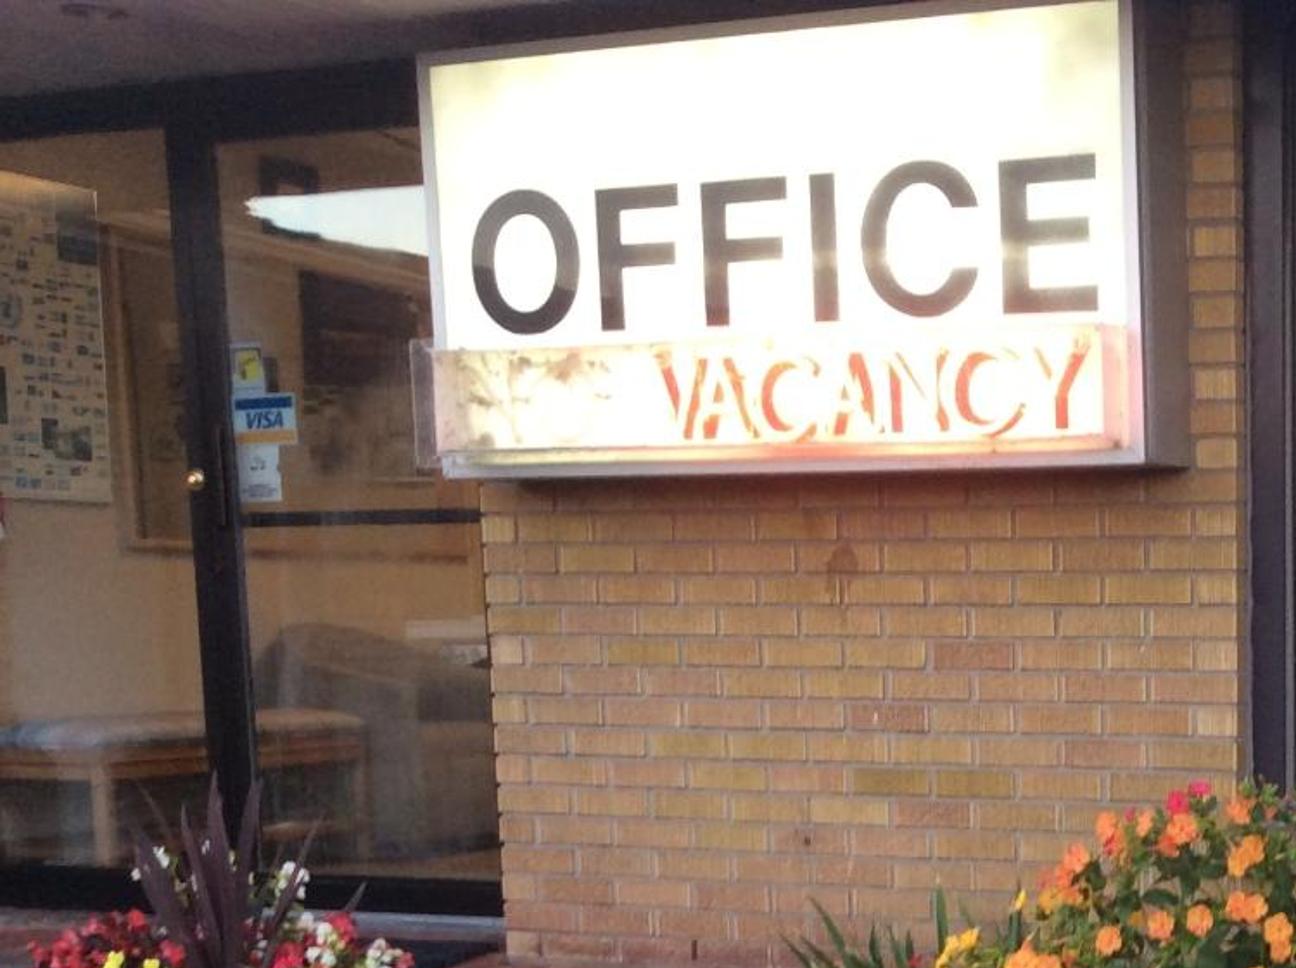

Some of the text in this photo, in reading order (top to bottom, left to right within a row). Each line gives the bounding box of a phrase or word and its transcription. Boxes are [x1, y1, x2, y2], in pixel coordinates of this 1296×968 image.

[471, 153, 1099, 335] OFFICE
[245, 410, 284, 429] VISA
[655, 337, 1091, 442] VACANCY
